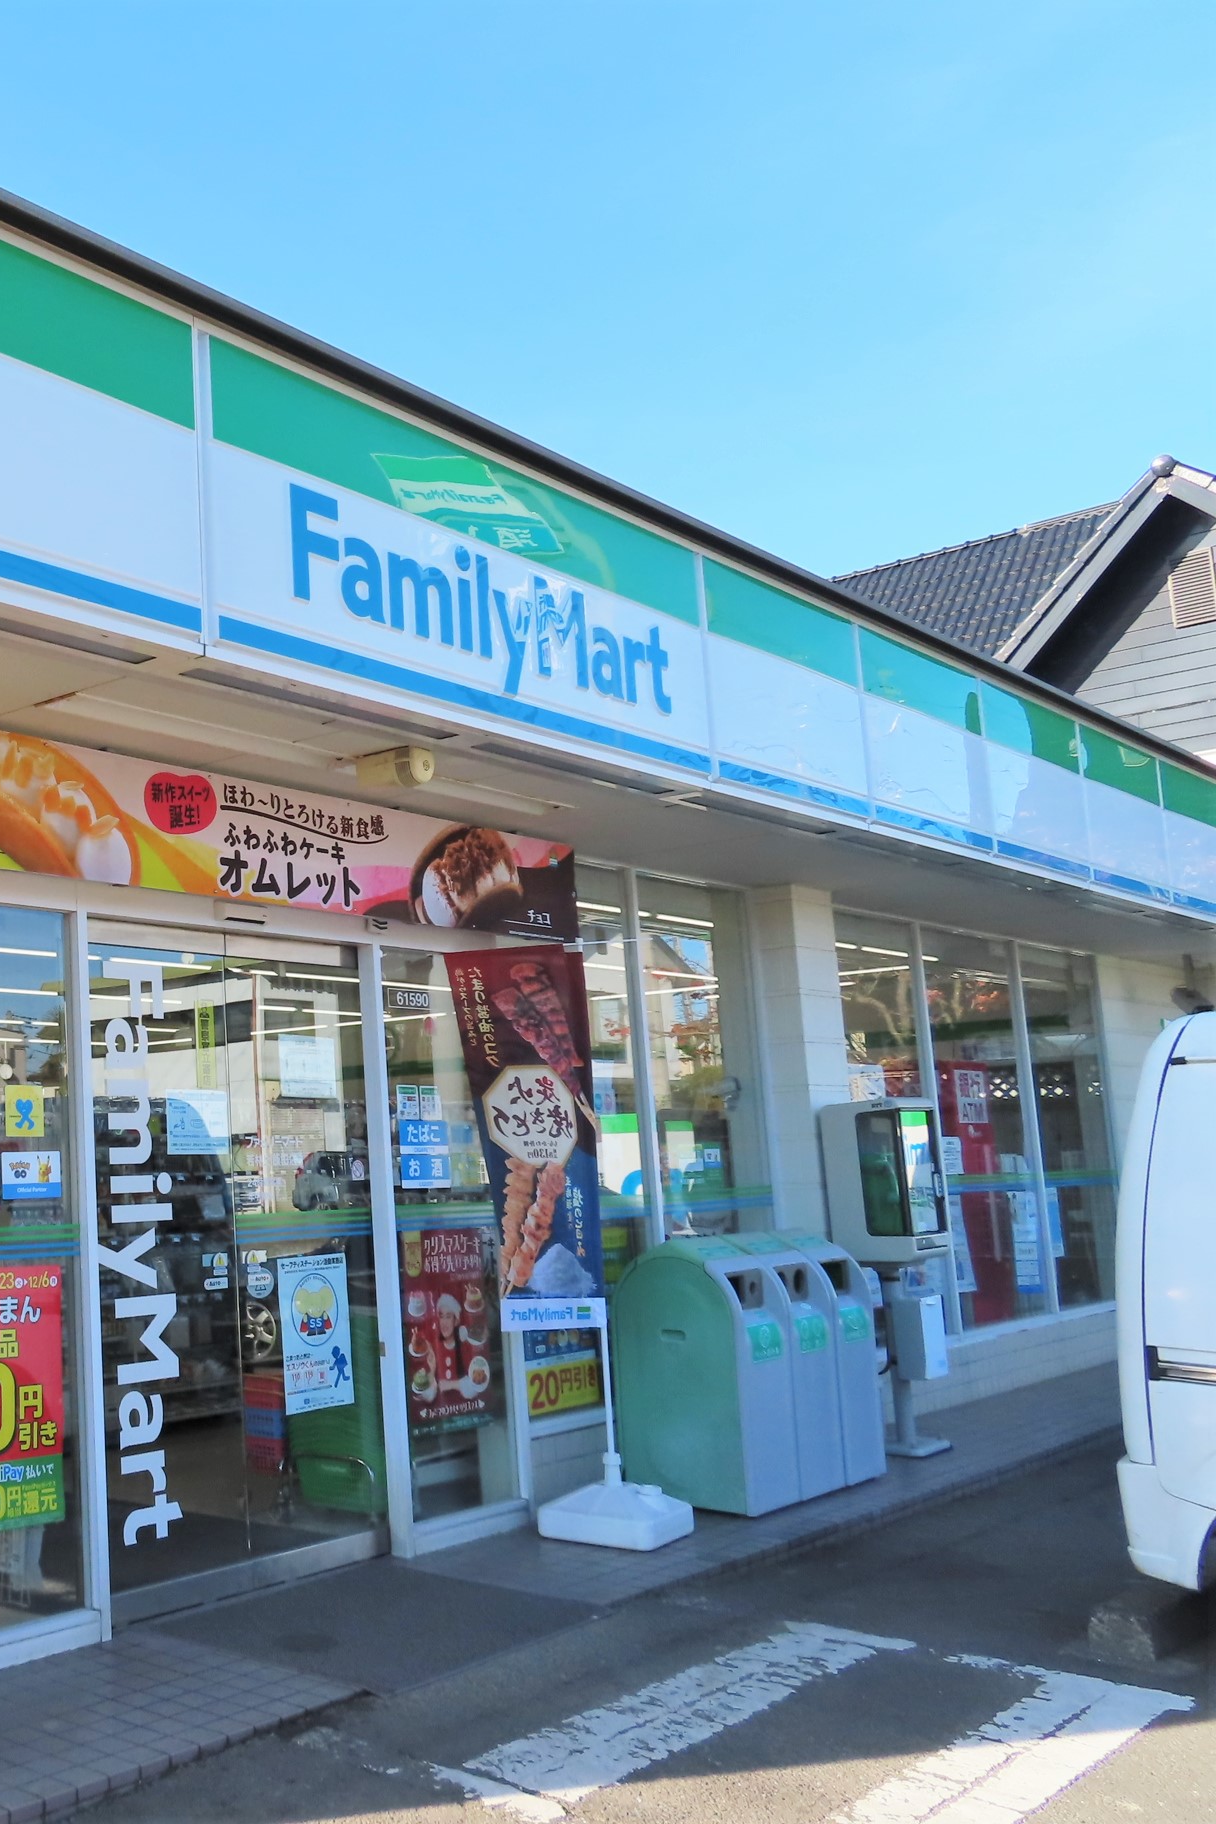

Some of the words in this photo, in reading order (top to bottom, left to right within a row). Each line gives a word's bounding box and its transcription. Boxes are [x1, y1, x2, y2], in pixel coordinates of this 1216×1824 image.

[289, 482, 672, 715] FamilyMart
[151, 783, 211, 803] 新作スイーツ
[169, 804, 201, 829] 誕生!
[223, 822, 347, 865] ふわふわケーキ
[220, 850, 361, 908] オムレット
[527, 909, 551, 925] チョコ
[396, 992, 429, 1007] 61590
[963, 1102, 985, 1121] ATM
[406, 1123, 441, 1143] たばこ
[14, 1170, 27, 1179] GO
[97, 960, 184, 1547] FamilyMart
[424, 1233, 481, 1256] クリスマスケーキ
[309, 1317, 323, 1328] SS
[529, 1364, 596, 1410] 20円引き
